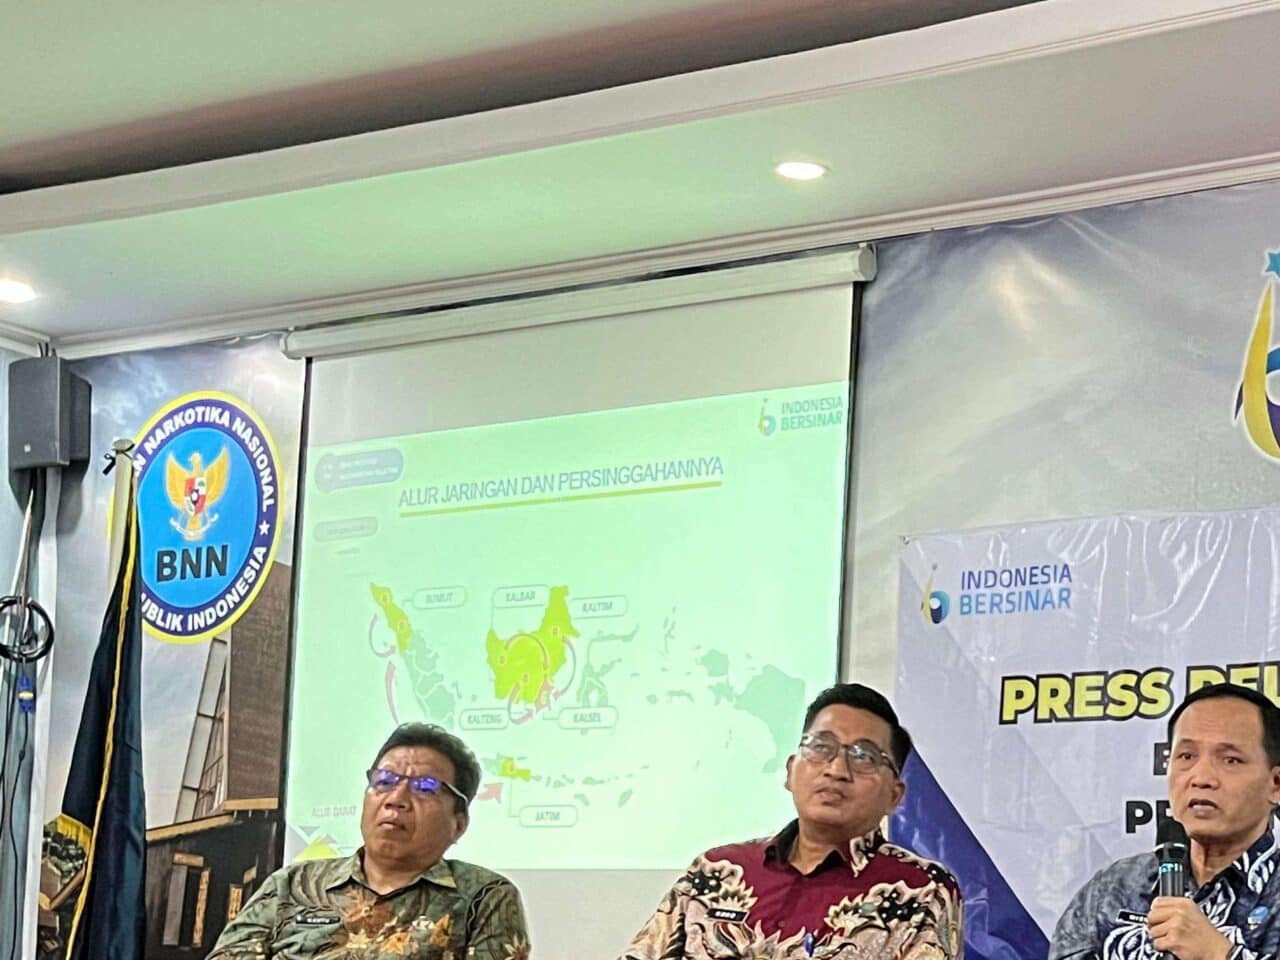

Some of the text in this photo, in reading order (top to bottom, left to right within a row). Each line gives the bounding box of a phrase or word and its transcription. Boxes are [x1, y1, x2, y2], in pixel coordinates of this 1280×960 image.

[780, 411, 843, 431] BERSINAR
[781, 396, 843, 414] INDONESIA
[143, 406, 275, 512] NARKOTIKA NASIONAL
[399, 456, 724, 508] ALUR JARINGAN DAN PERSINGGAHANNYA
[156, 544, 228, 582] BNN
[961, 563, 1072, 590] INDONESIA
[187, 545, 268, 632] INDONESIA
[960, 587, 1072, 616] BERSINAR
[999, 667, 1174, 725] PRESS
